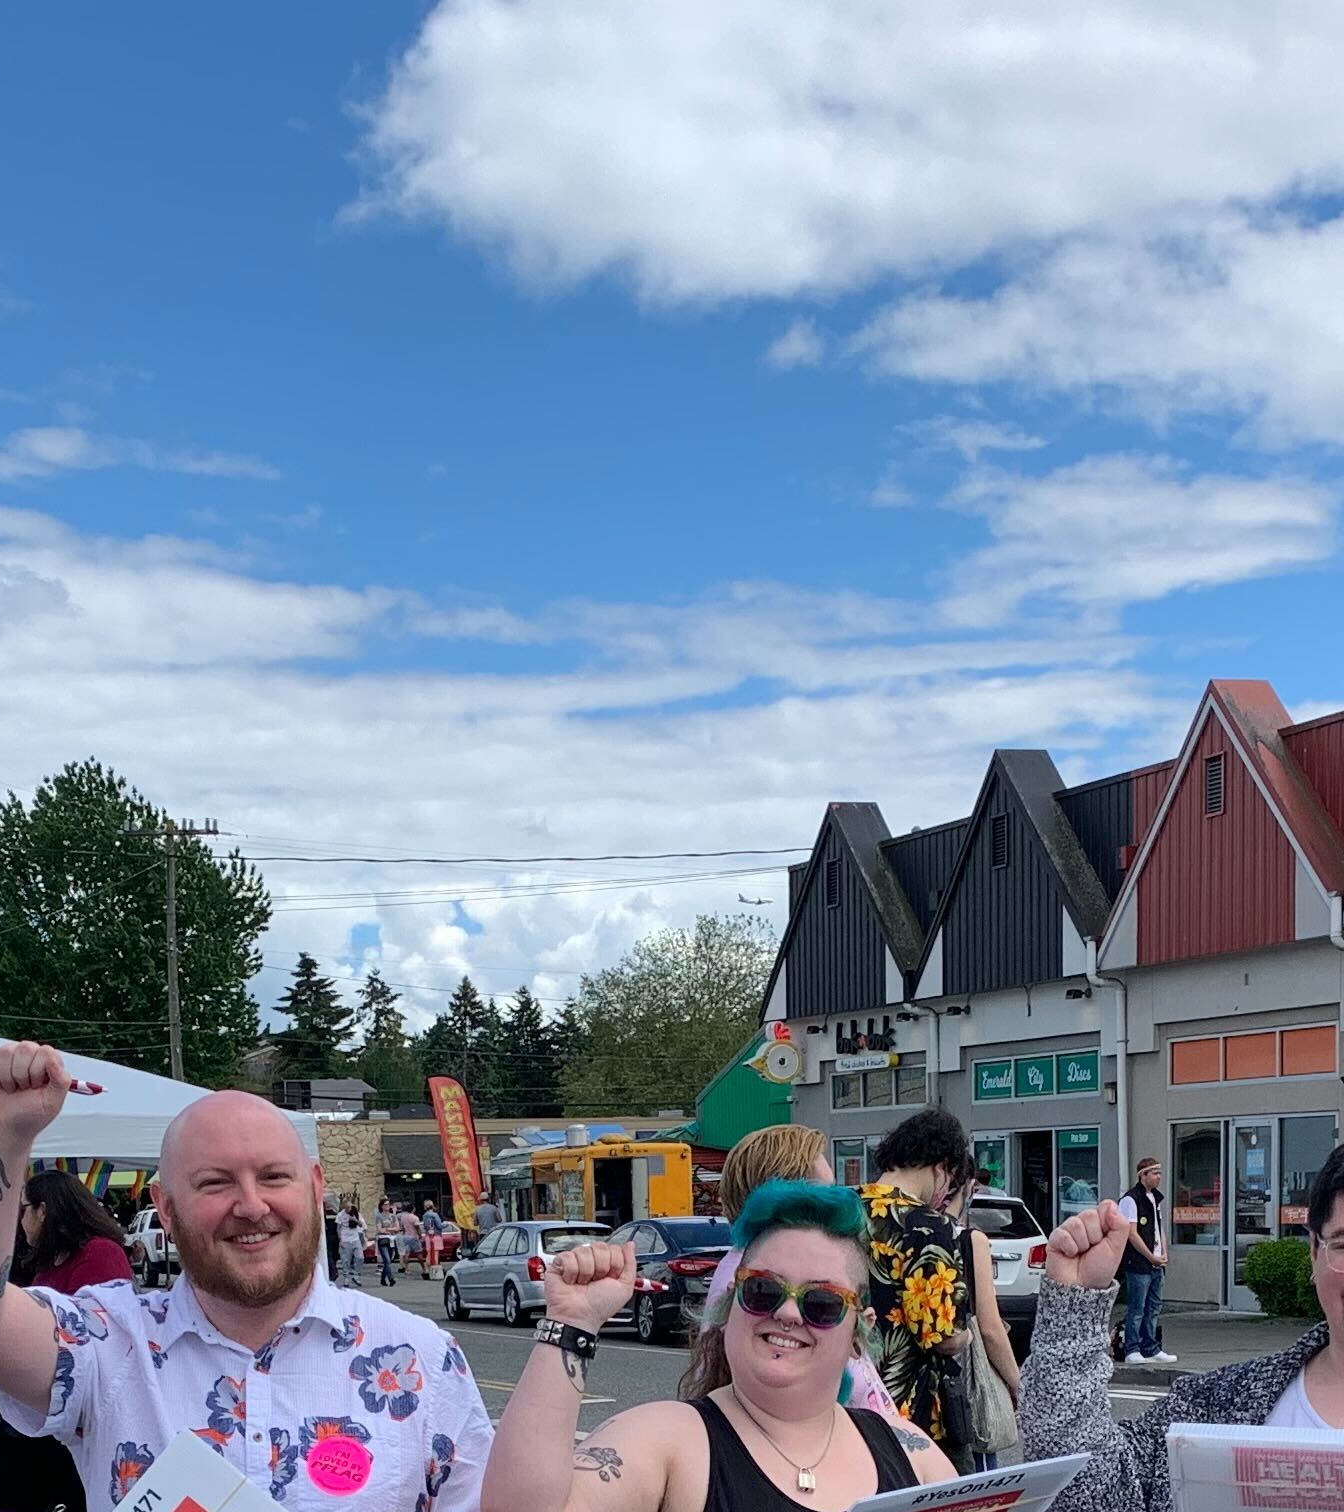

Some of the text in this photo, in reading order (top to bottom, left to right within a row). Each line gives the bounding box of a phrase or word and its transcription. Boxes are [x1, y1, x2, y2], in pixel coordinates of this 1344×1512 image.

[982, 1062, 1091, 1091] Emerald City Discs
[311, 1460, 365, 1483] PFLAG
[350, 1463, 363, 1471] BY
[911, 1473, 1026, 1505] #YesOn1471
